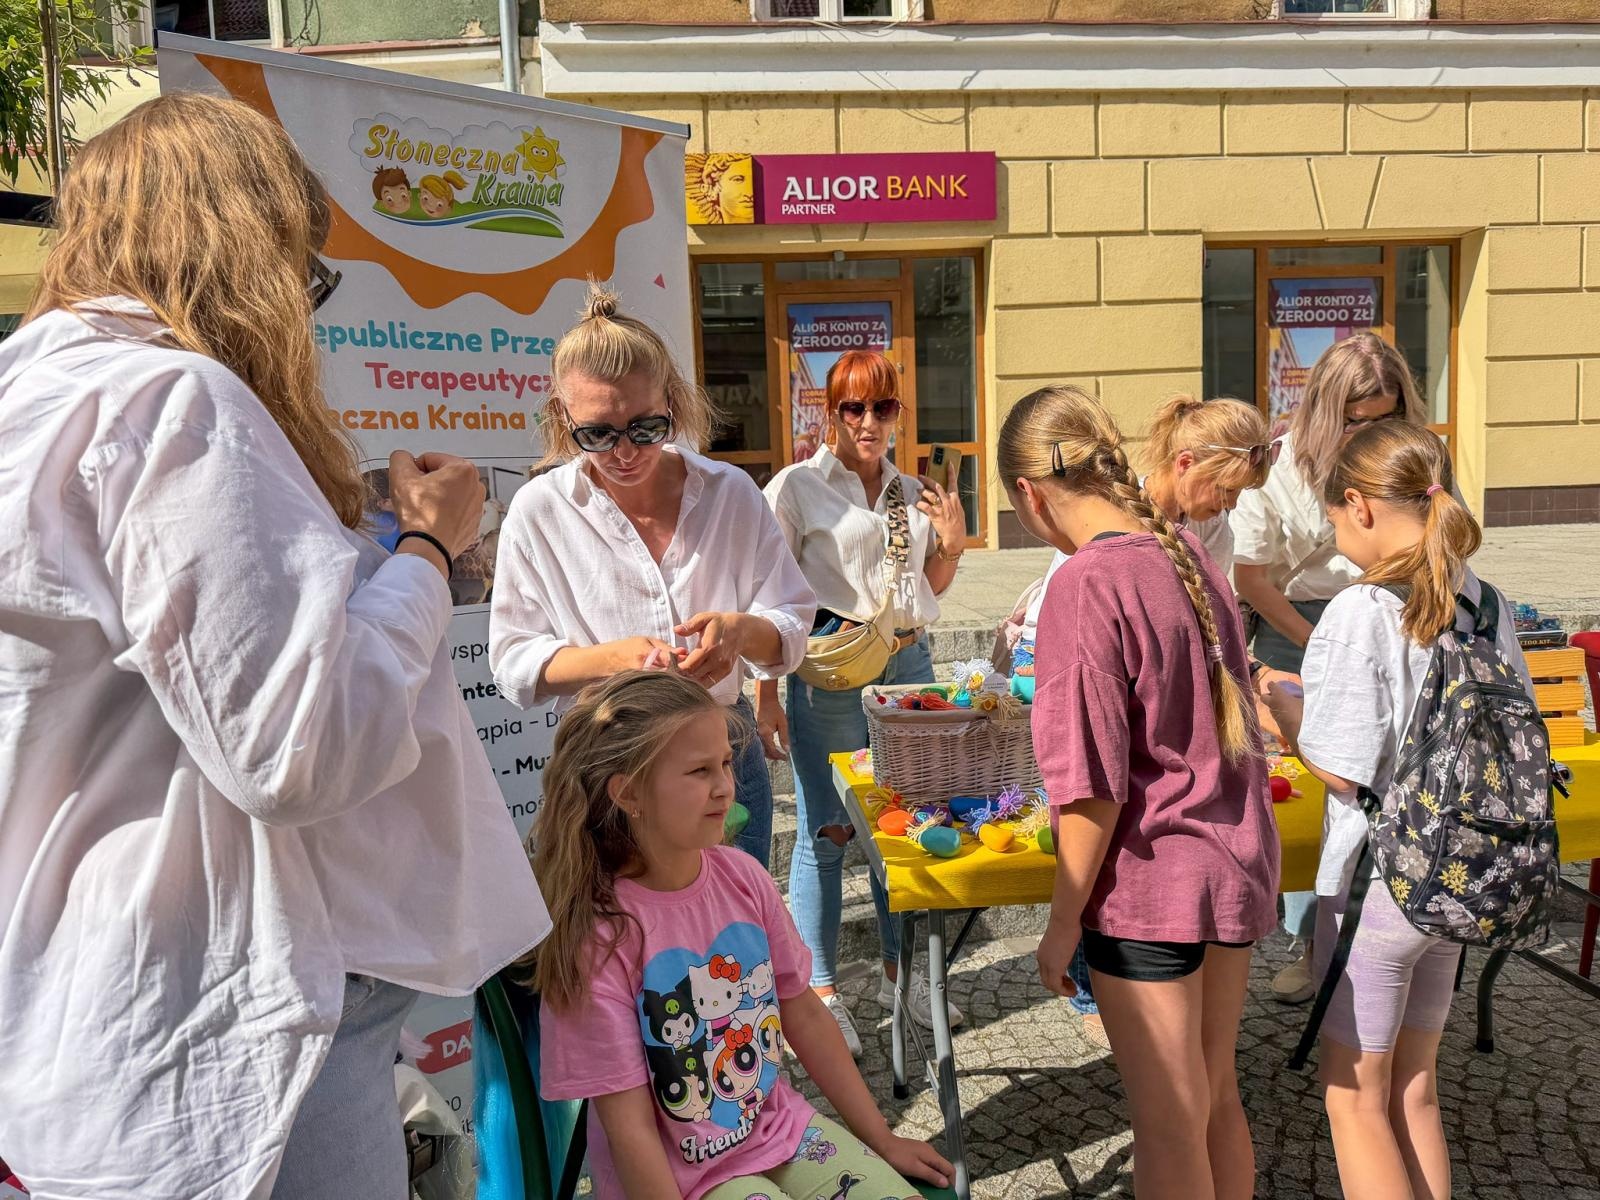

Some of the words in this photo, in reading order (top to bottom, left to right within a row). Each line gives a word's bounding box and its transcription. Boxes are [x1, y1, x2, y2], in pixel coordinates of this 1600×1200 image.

[363, 124, 520, 177] Słoneczna
[471, 172, 564, 207] Kraina
[782, 176, 880, 201] ALIOR
[887, 174, 968, 200] BANK
[782, 203, 836, 215] PARTNER
[1276, 296, 1312, 307] ALIOR
[1314, 295, 1355, 307] KONTO
[1358, 295, 1374, 305] ZA
[1276, 309, 1349, 323] ZEROOOO
[792, 323, 828, 334] ALIOR
[830, 321, 869, 333] KONTO
[872, 321, 887, 331] ZA
[793, 334, 864, 348] ZEROOOO
[427, 404, 525, 431] Kraina
[680, 1115, 754, 1164] Friends
